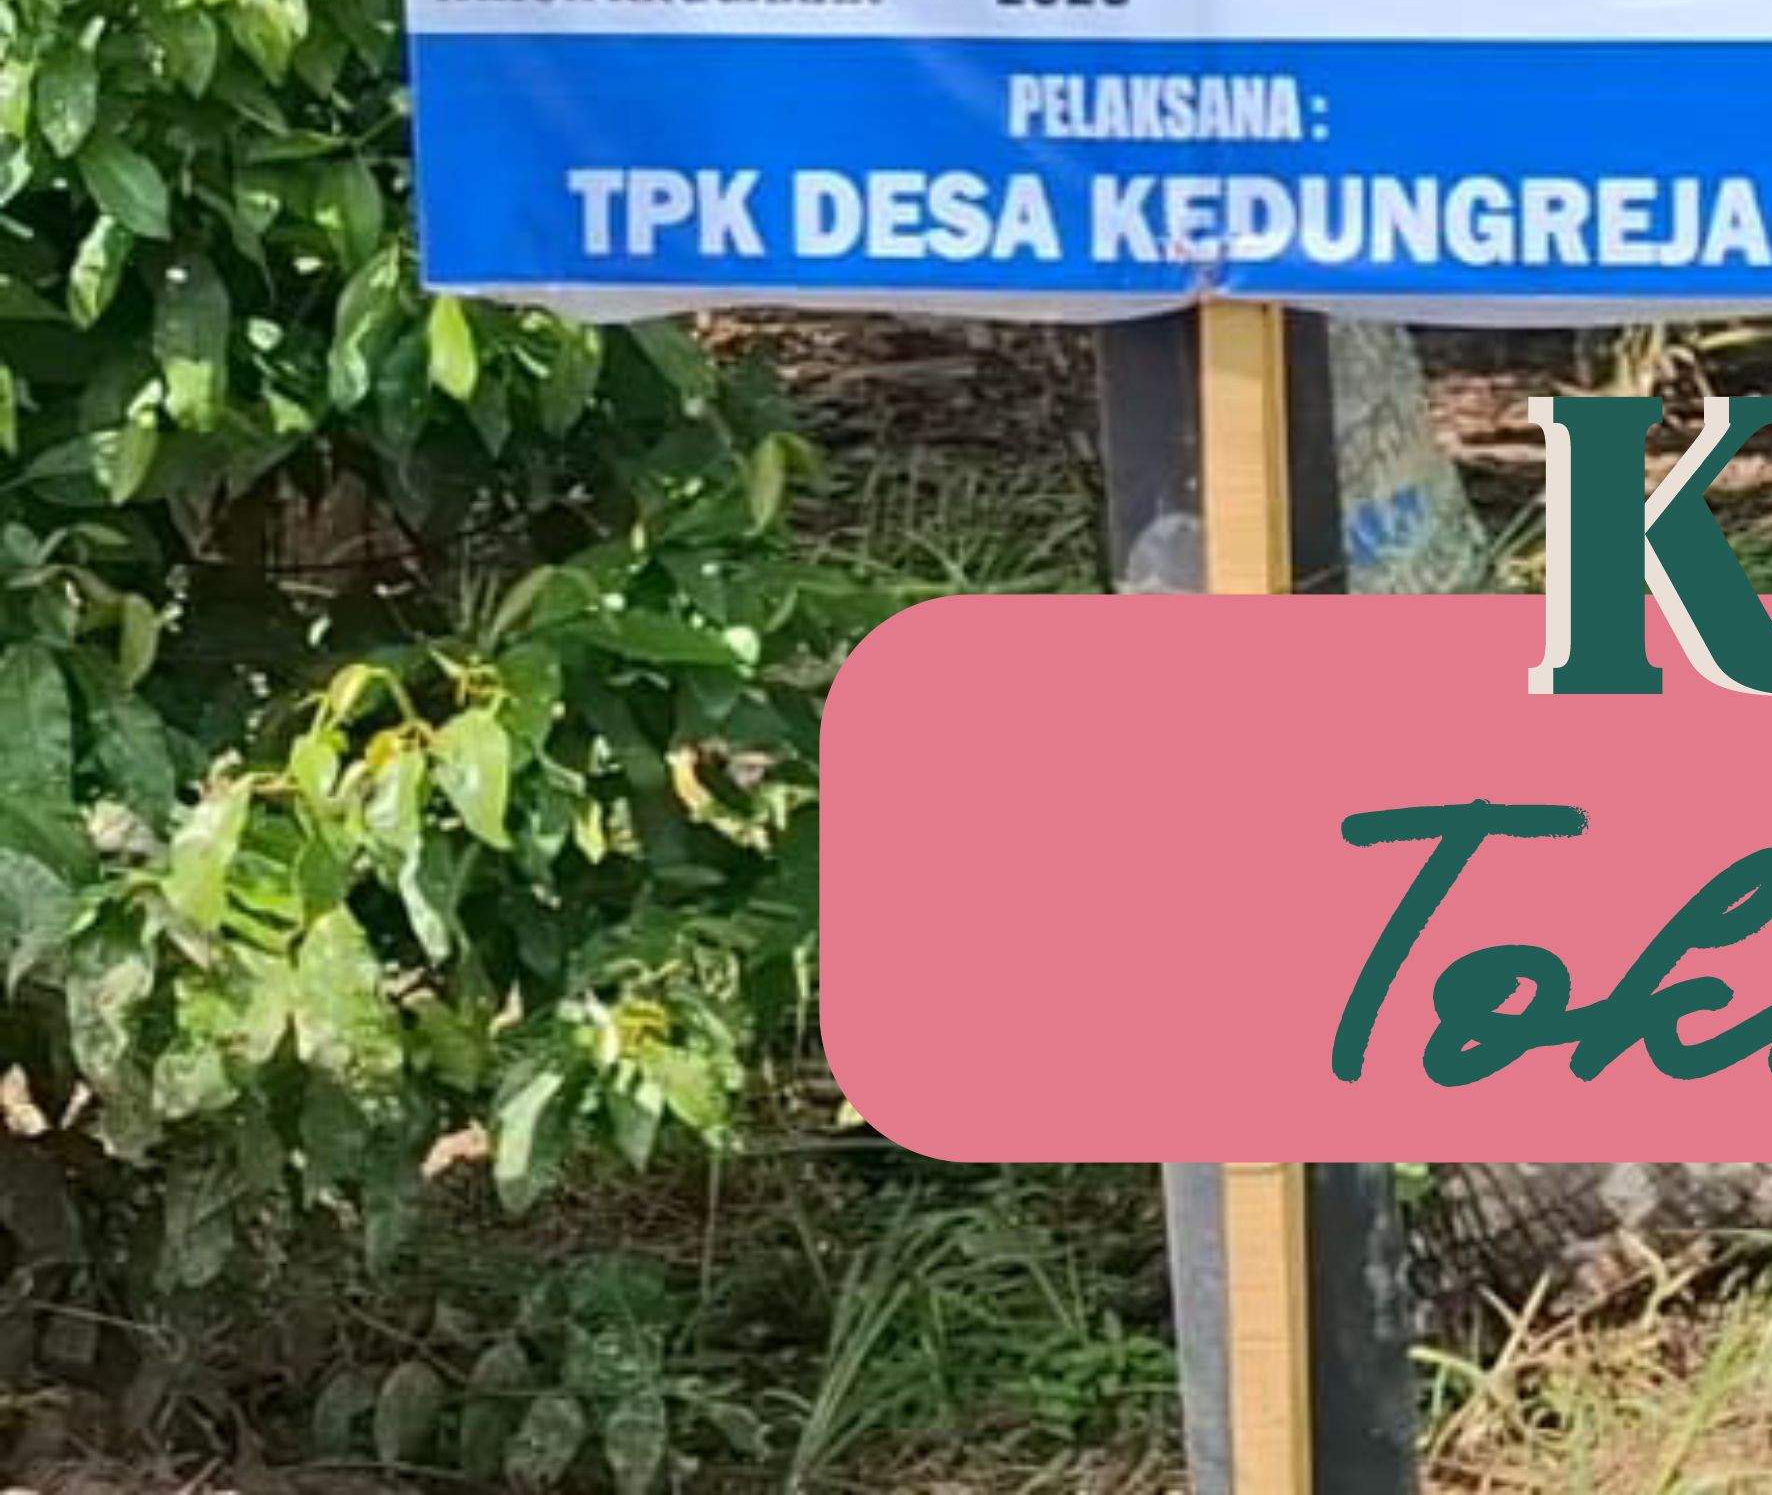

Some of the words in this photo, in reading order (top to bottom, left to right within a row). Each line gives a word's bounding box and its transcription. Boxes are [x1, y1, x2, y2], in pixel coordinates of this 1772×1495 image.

[568, 169, 765, 257] TPK
[794, 170, 1061, 260] DESA
[1092, 175, 1772, 266] KEDUNGREJA
